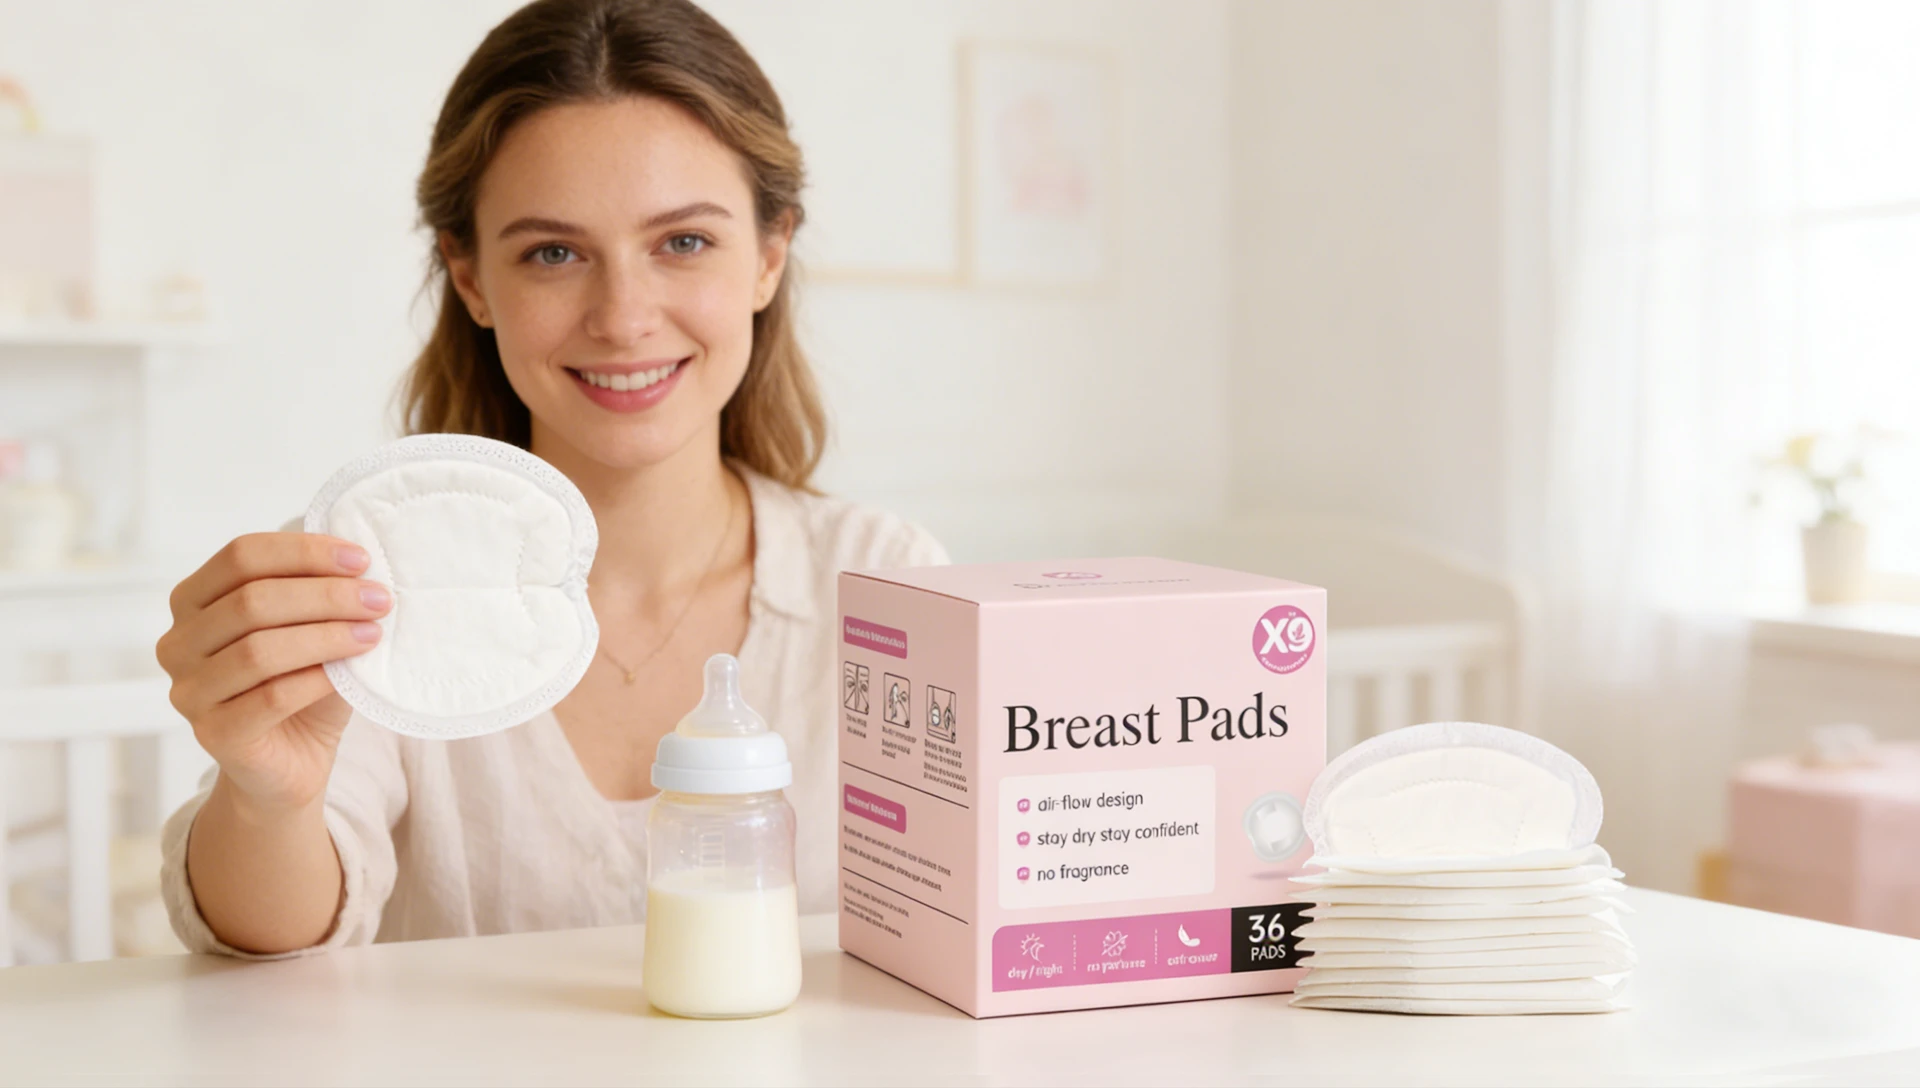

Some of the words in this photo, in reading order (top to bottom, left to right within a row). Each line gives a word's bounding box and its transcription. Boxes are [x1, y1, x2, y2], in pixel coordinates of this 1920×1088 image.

[1002, 703, 1162, 753] Breast
[1176, 691, 1289, 743] Pads
[1037, 794, 1091, 812] air-flow
[1096, 791, 1144, 810] design
[1037, 832, 1068, 848] stay
[1072, 828, 1096, 846] dry
[1100, 827, 1131, 843] stay
[1135, 821, 1200, 839] confident
[1037, 869, 1056, 881] no
[1060, 863, 1130, 882] fragrance
[1248, 914, 1286, 943] 36
[1250, 944, 1287, 962] PADS
